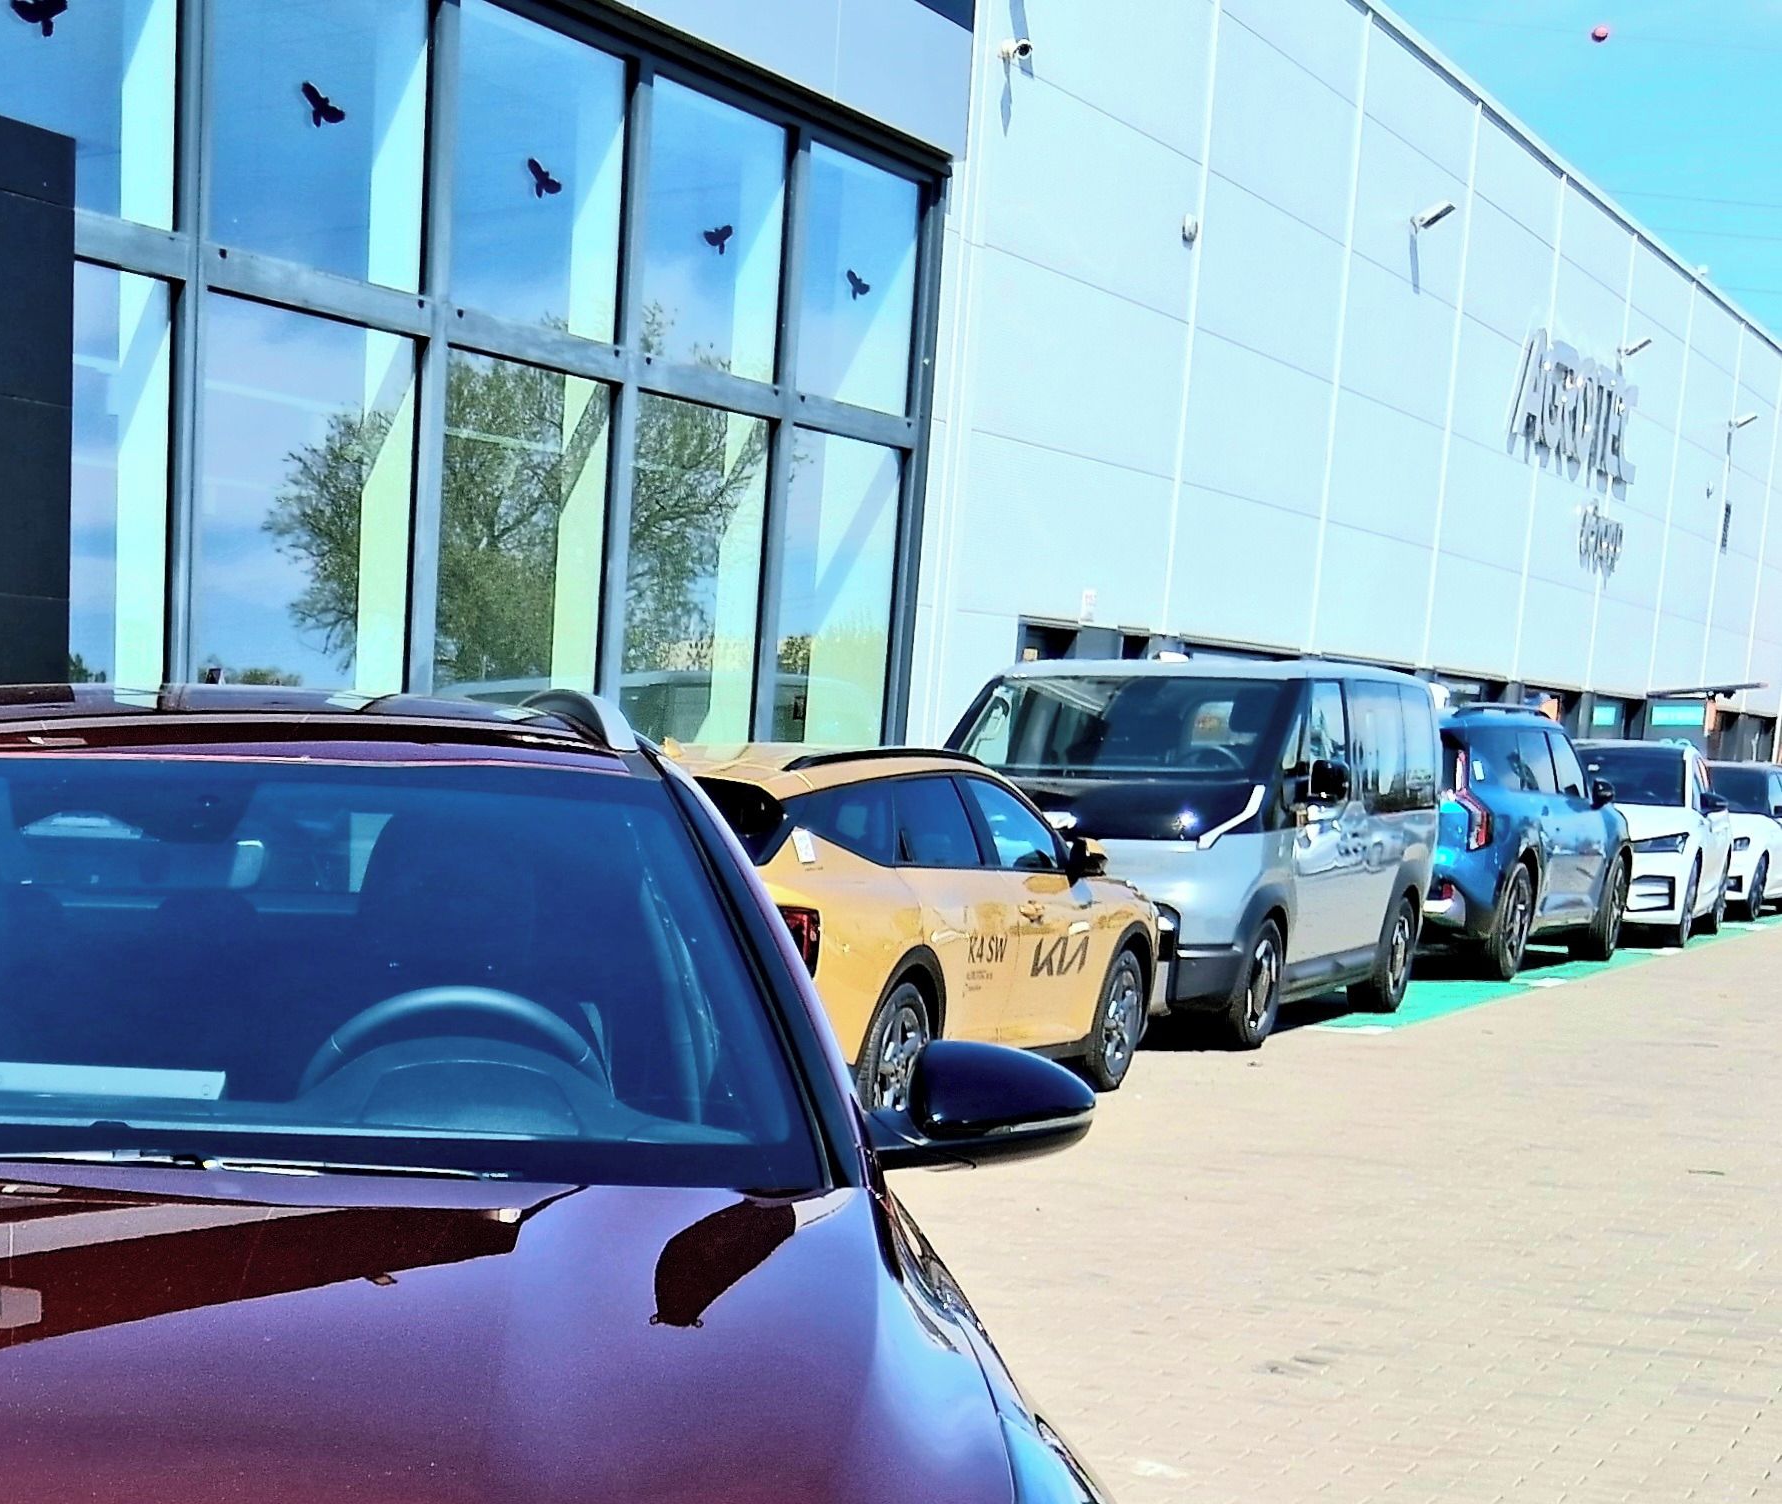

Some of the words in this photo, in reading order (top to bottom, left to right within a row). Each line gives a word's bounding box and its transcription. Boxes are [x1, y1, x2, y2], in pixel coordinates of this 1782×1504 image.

[968, 932, 985, 963] K4
[986, 932, 1008, 963] SW
[1030, 935, 1090, 977] KIA
